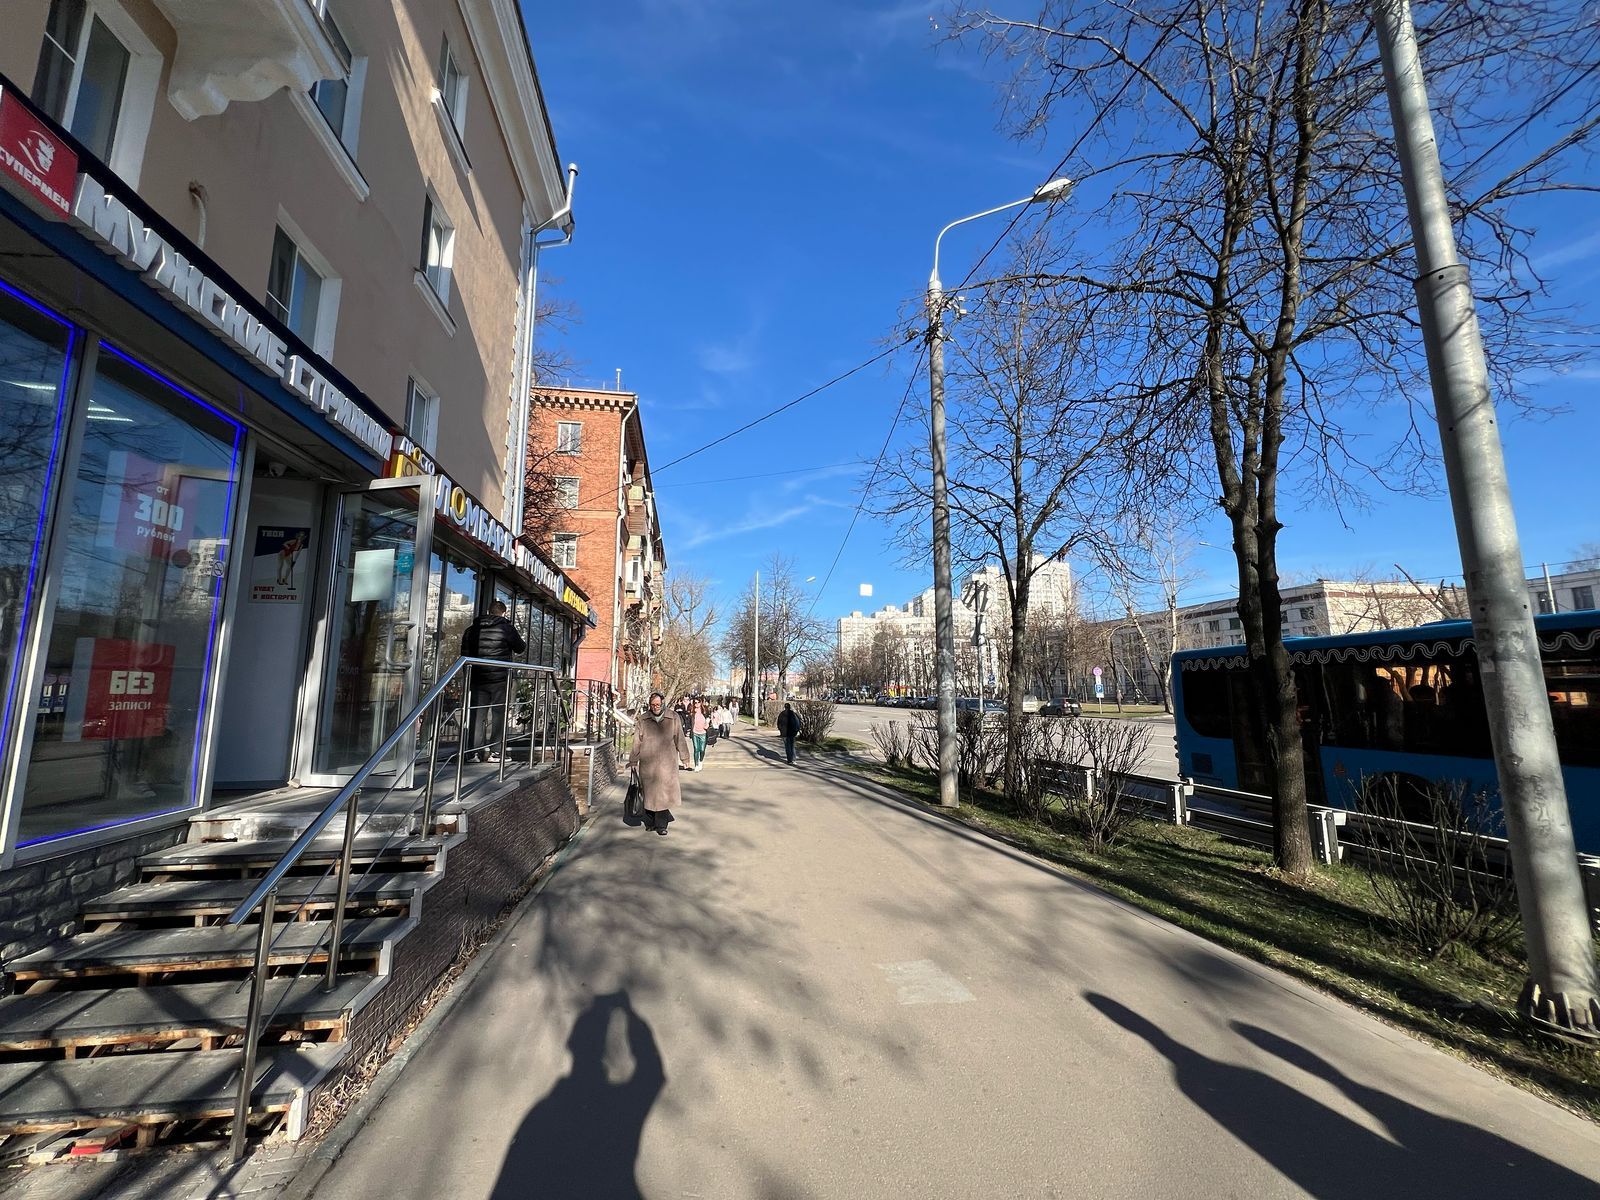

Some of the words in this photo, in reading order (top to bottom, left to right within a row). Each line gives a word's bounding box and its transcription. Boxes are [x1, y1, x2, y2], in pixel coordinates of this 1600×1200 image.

[75, 173, 288, 378] МУЖСКИЕ
[289, 354, 393, 461] СТРИЖКИ
[399, 436, 436, 476] ПРОСТО
[156, 485, 169, 495] от
[134, 492, 184, 531] 300
[435, 474, 516, 565] ЛОМБАРД
[136, 525, 175, 543] рублей
[109, 670, 155, 695] БЕЗ
[108, 701, 151, 711] записи
